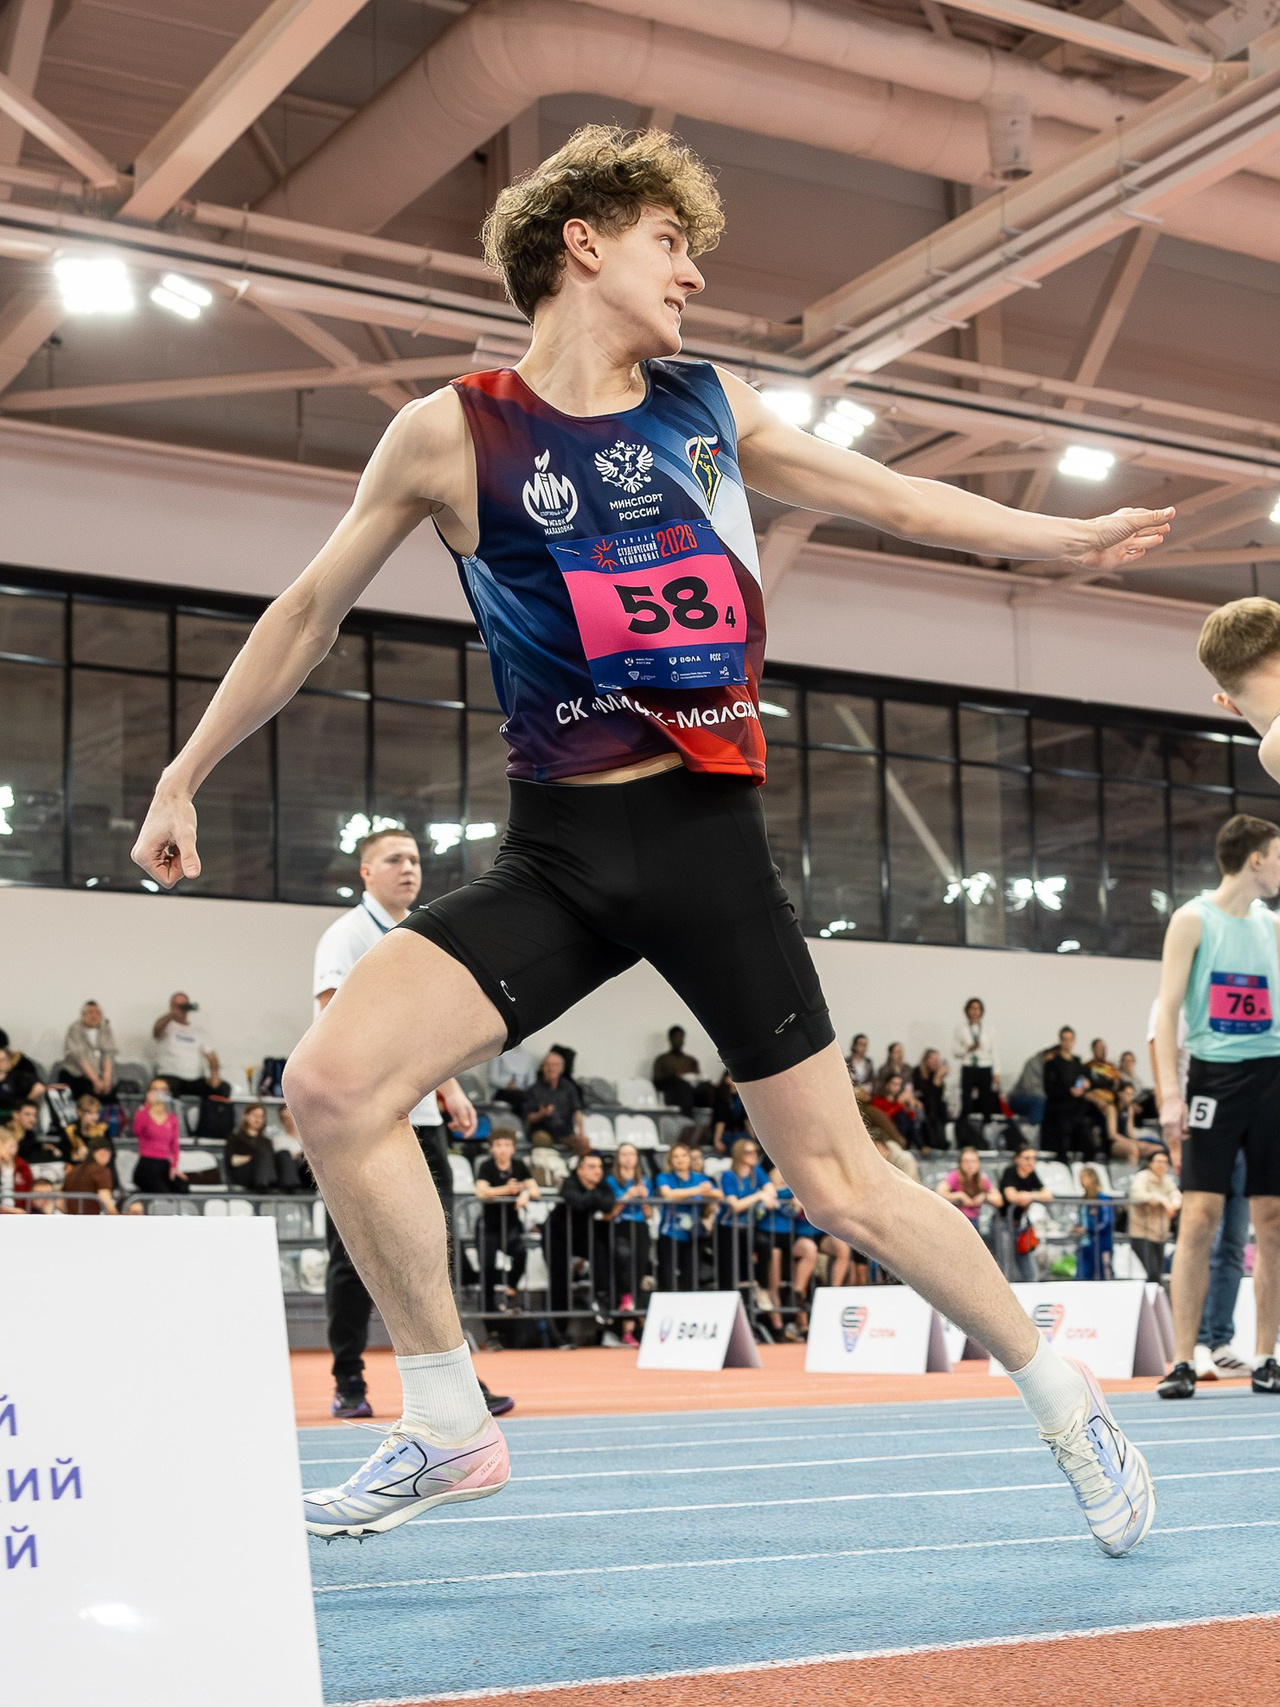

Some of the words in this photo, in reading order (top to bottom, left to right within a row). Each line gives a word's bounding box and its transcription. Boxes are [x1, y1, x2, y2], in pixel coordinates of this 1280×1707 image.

[609, 493, 663, 510] МИНСПОРТ
[619, 506, 660, 521] РОССИИ
[613, 576, 719, 634] 58
[725, 606, 736, 628] 4
[556, 697, 589, 724] СК
[1226, 992, 1256, 1015] 76
[1195, 1102, 1208, 1121] 5
